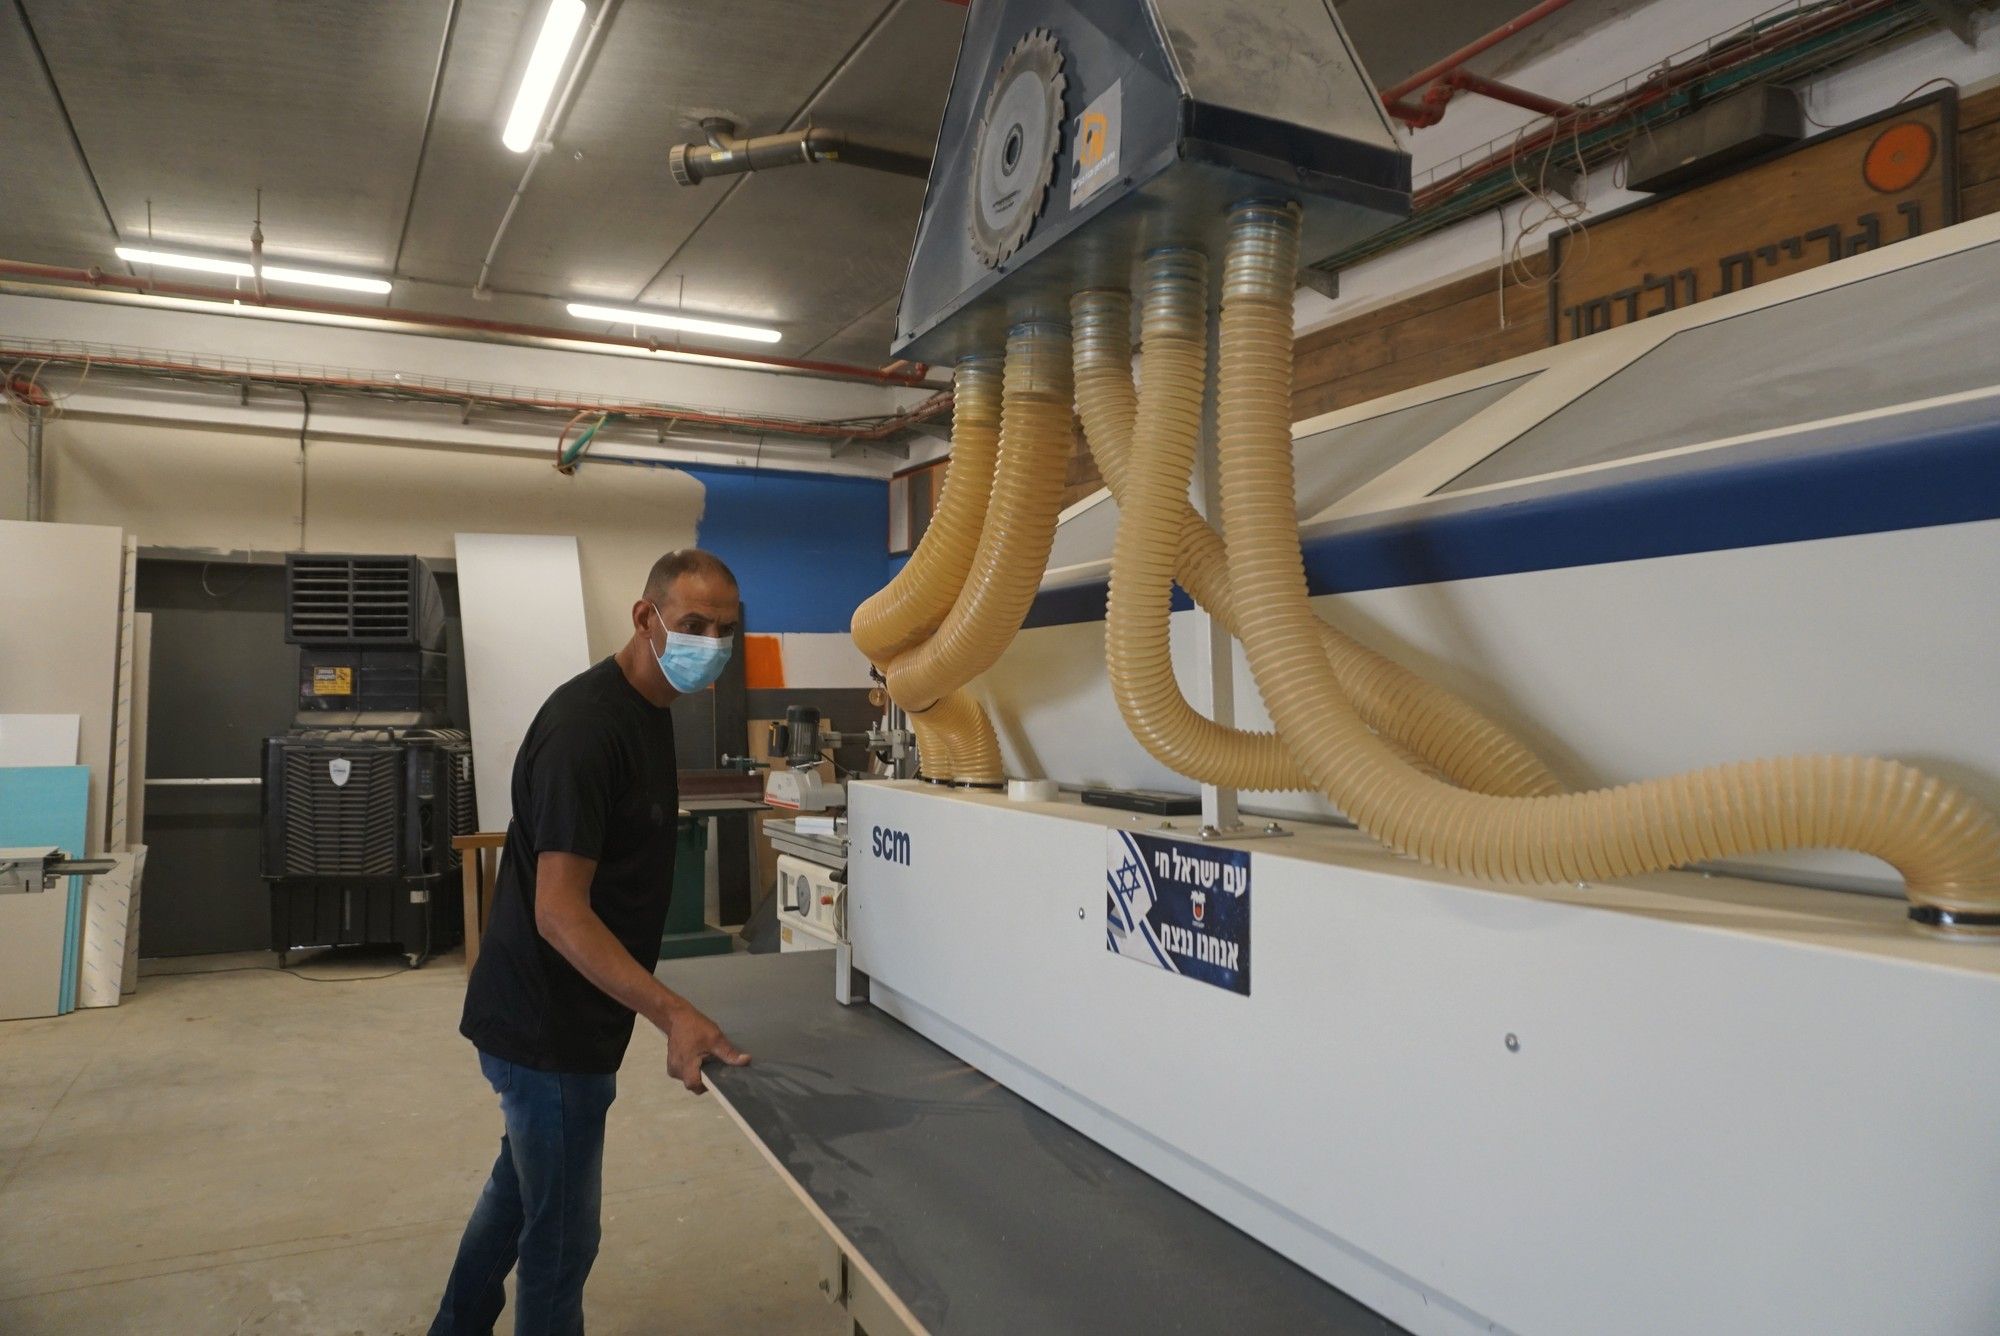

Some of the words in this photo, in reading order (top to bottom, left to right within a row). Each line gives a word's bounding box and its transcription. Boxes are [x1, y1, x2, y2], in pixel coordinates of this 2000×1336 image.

[872, 825, 911, 866] scm
[1155, 851, 1170, 879] חי
[1172, 847, 1220, 888] ישראל
[1223, 864, 1246, 898] עם
[1161, 922, 1193, 957] ננצח
[1197, 933, 1239, 972] אנחנו
